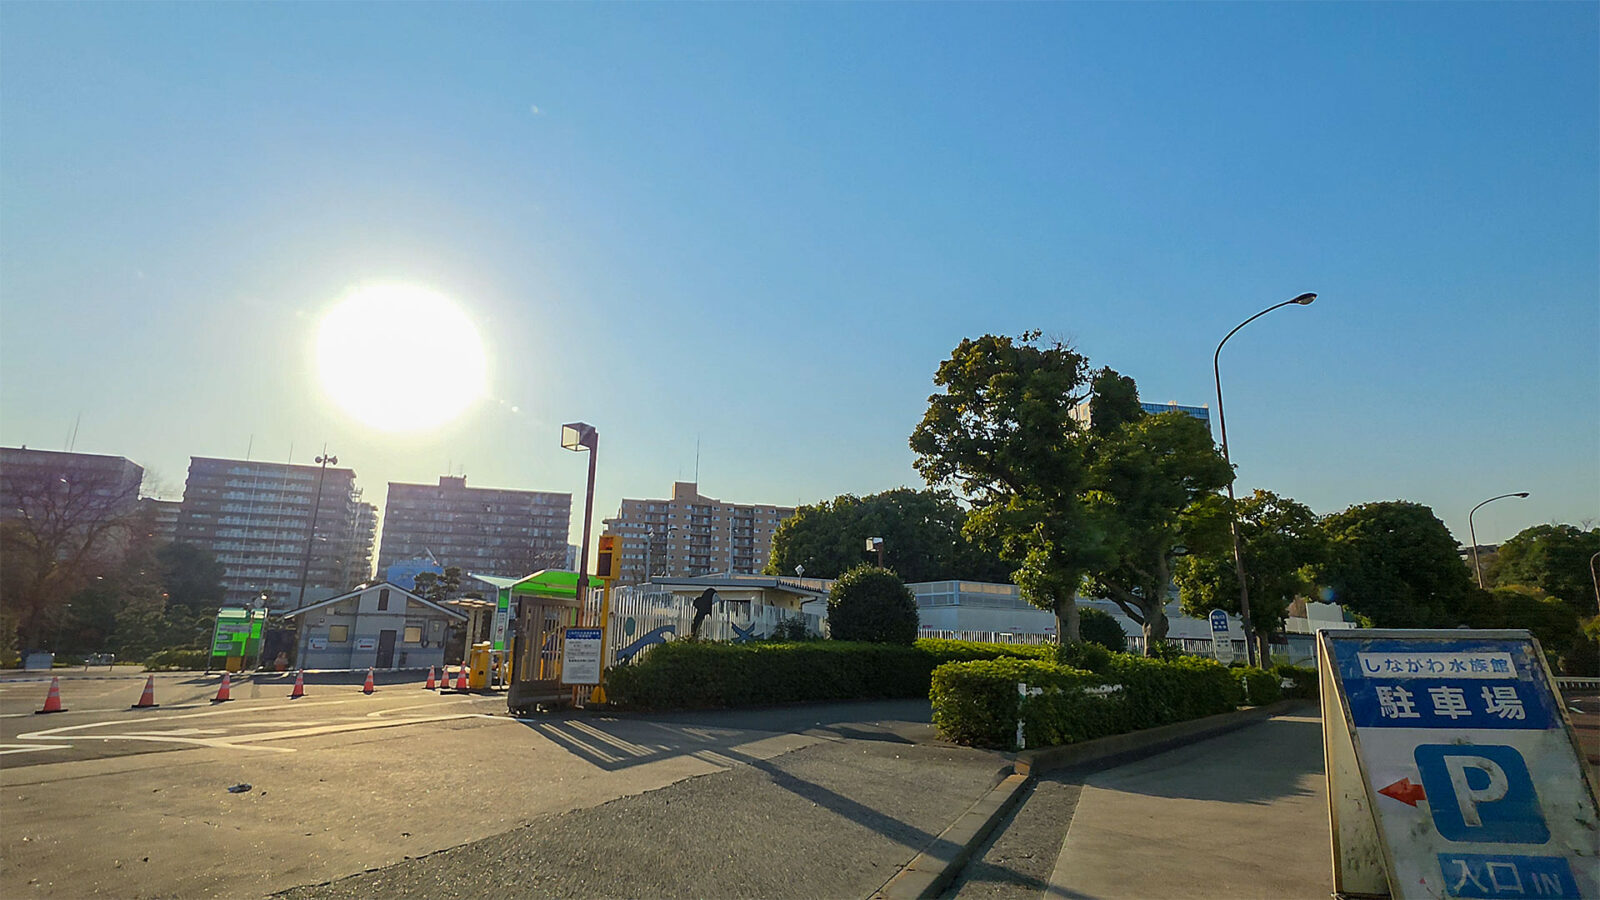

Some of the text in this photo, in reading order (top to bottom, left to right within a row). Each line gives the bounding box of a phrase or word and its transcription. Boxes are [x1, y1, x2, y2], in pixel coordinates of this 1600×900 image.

[1365, 657, 1510, 673] しながわ水族館
[1375, 685, 1526, 720] 駐車場
[1443, 755, 1509, 827] P
[1451, 859, 1562, 894] 入口 IN
